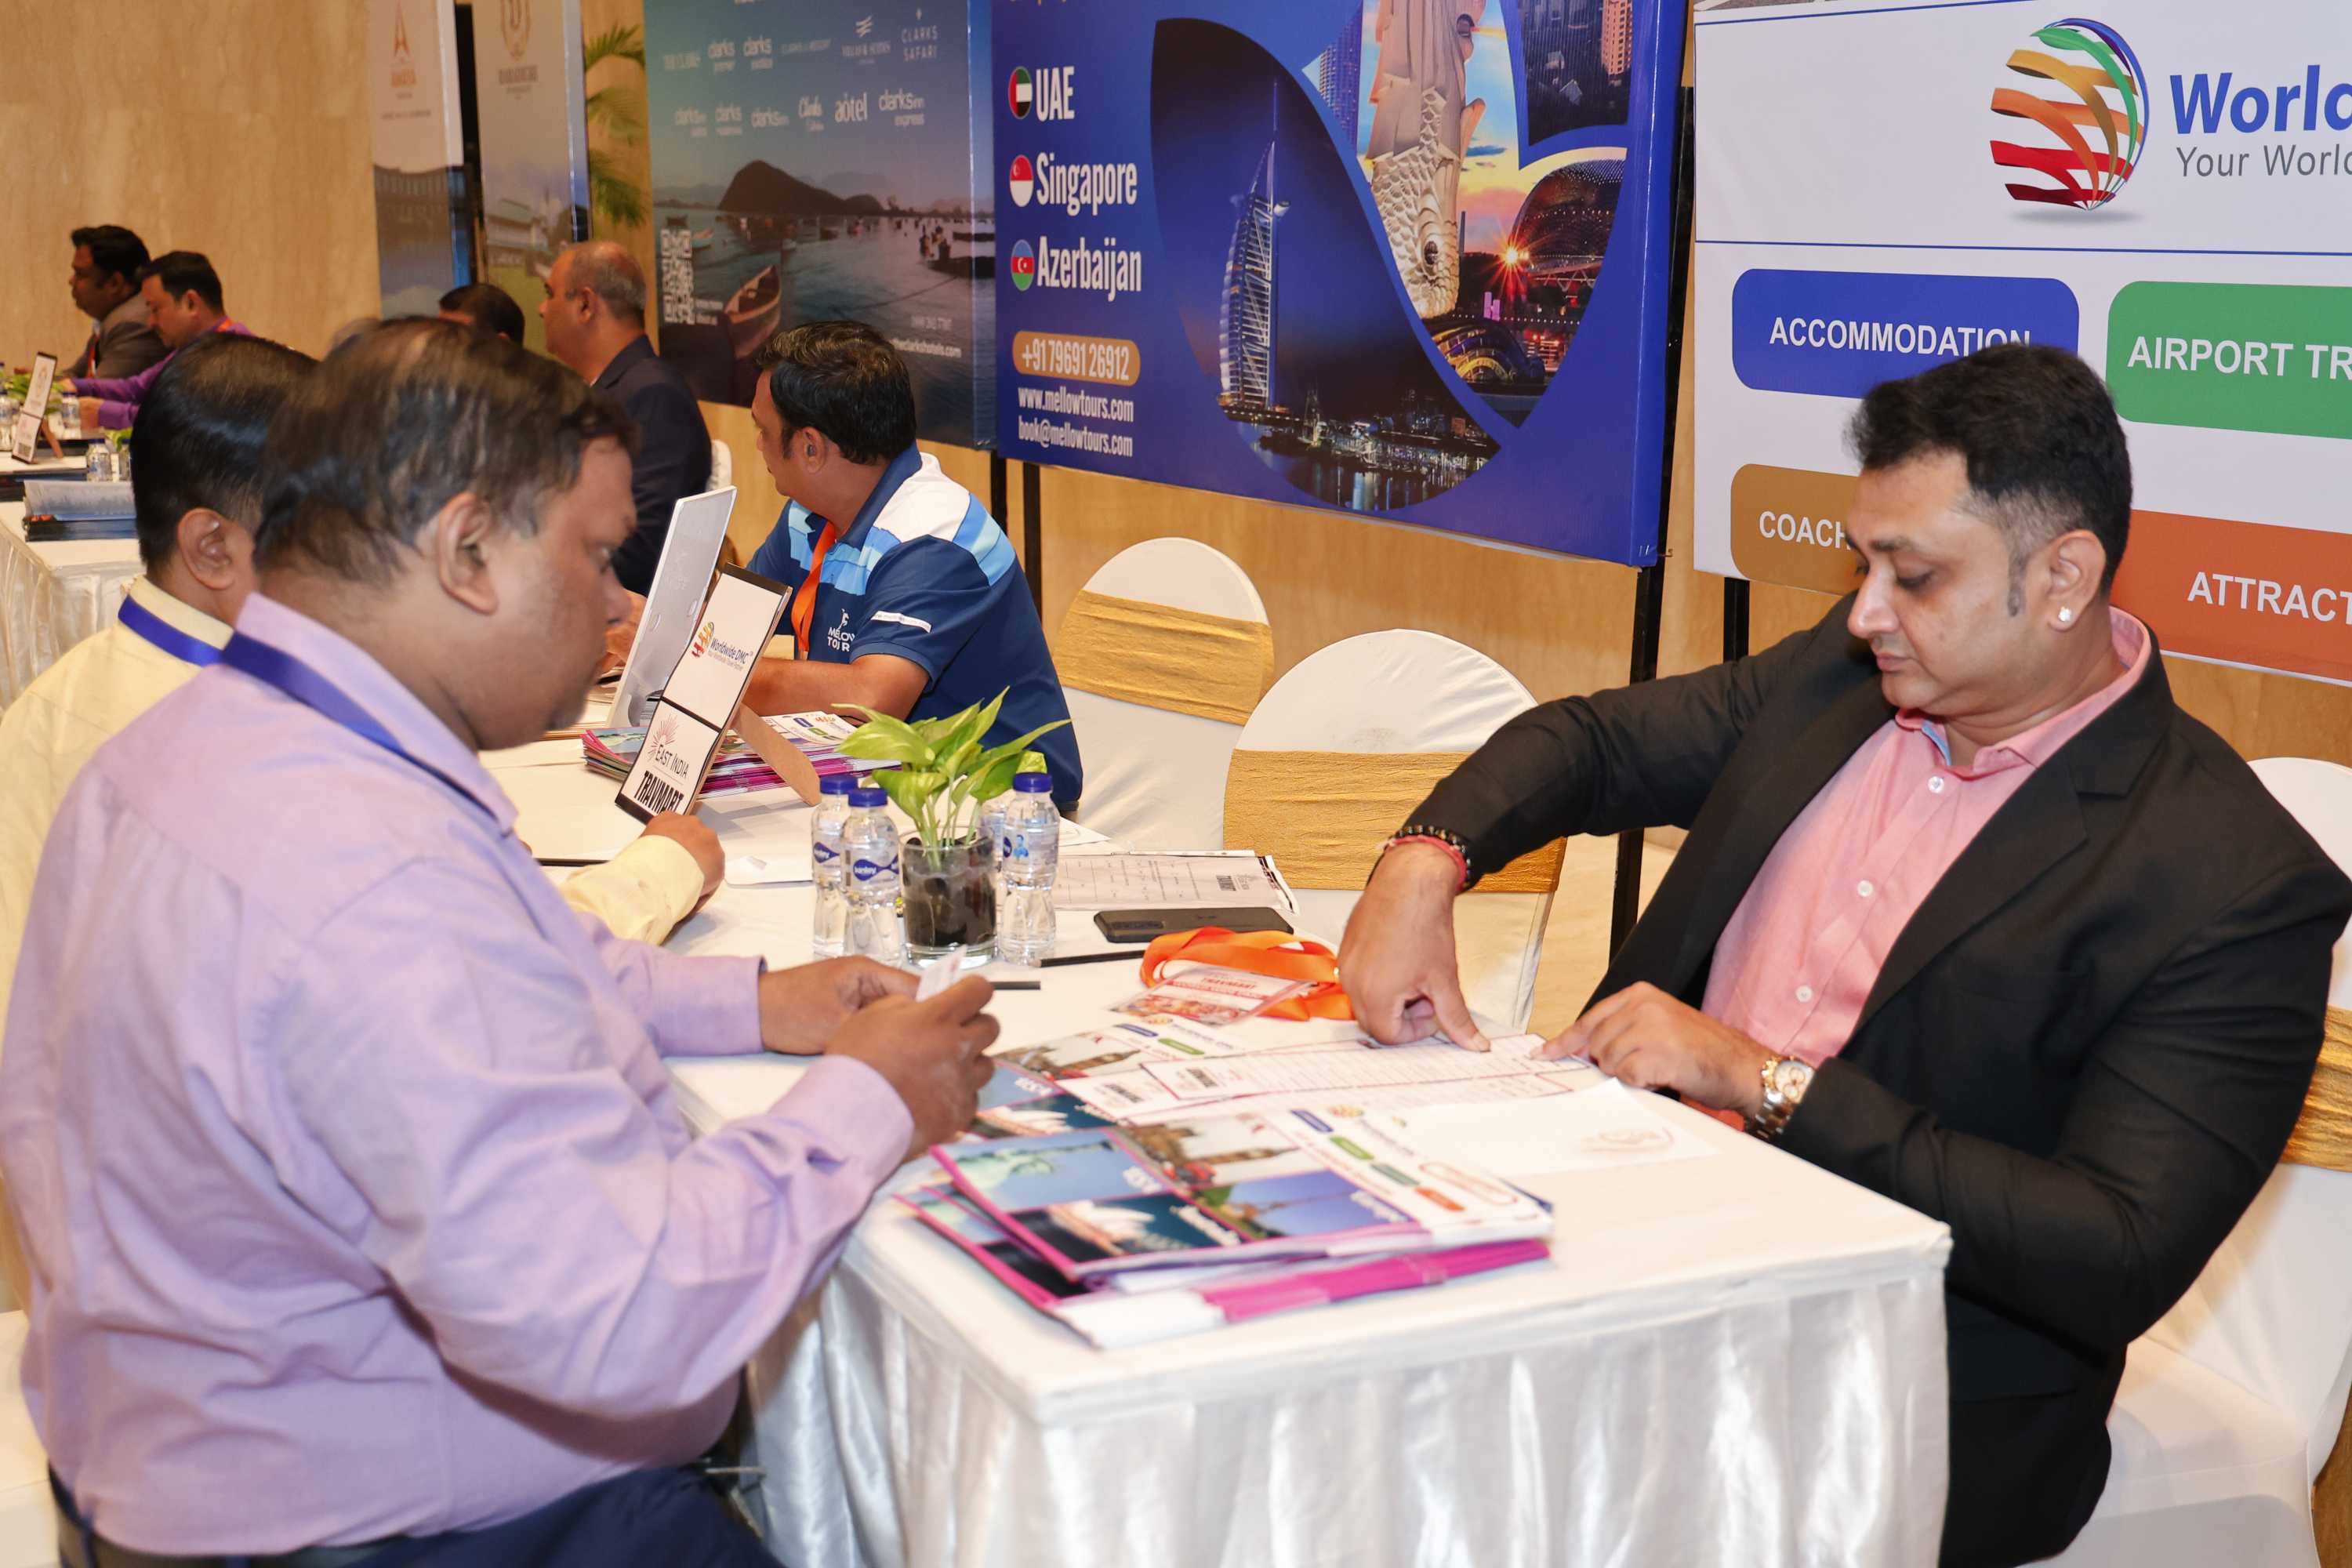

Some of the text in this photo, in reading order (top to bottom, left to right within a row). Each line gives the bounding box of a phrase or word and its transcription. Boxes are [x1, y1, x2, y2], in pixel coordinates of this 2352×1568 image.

[1036, 66, 1075, 122] UAE
[2176, 147, 2250, 177] Your
[1036, 152, 1138, 216] Singapore
[1037, 236, 1142, 302] Azerbaijan
[1022, 338, 1130, 381] +91 79691 26912
[2127, 336, 2294, 376] AIRPORT
[1018, 386, 1134, 423] www.mellowtours.com
[1018, 416, 1133, 457] book@mellowtours.com
[655, 744, 689, 779] EAST INDIA
[633, 770, 684, 815] TRAVMART
